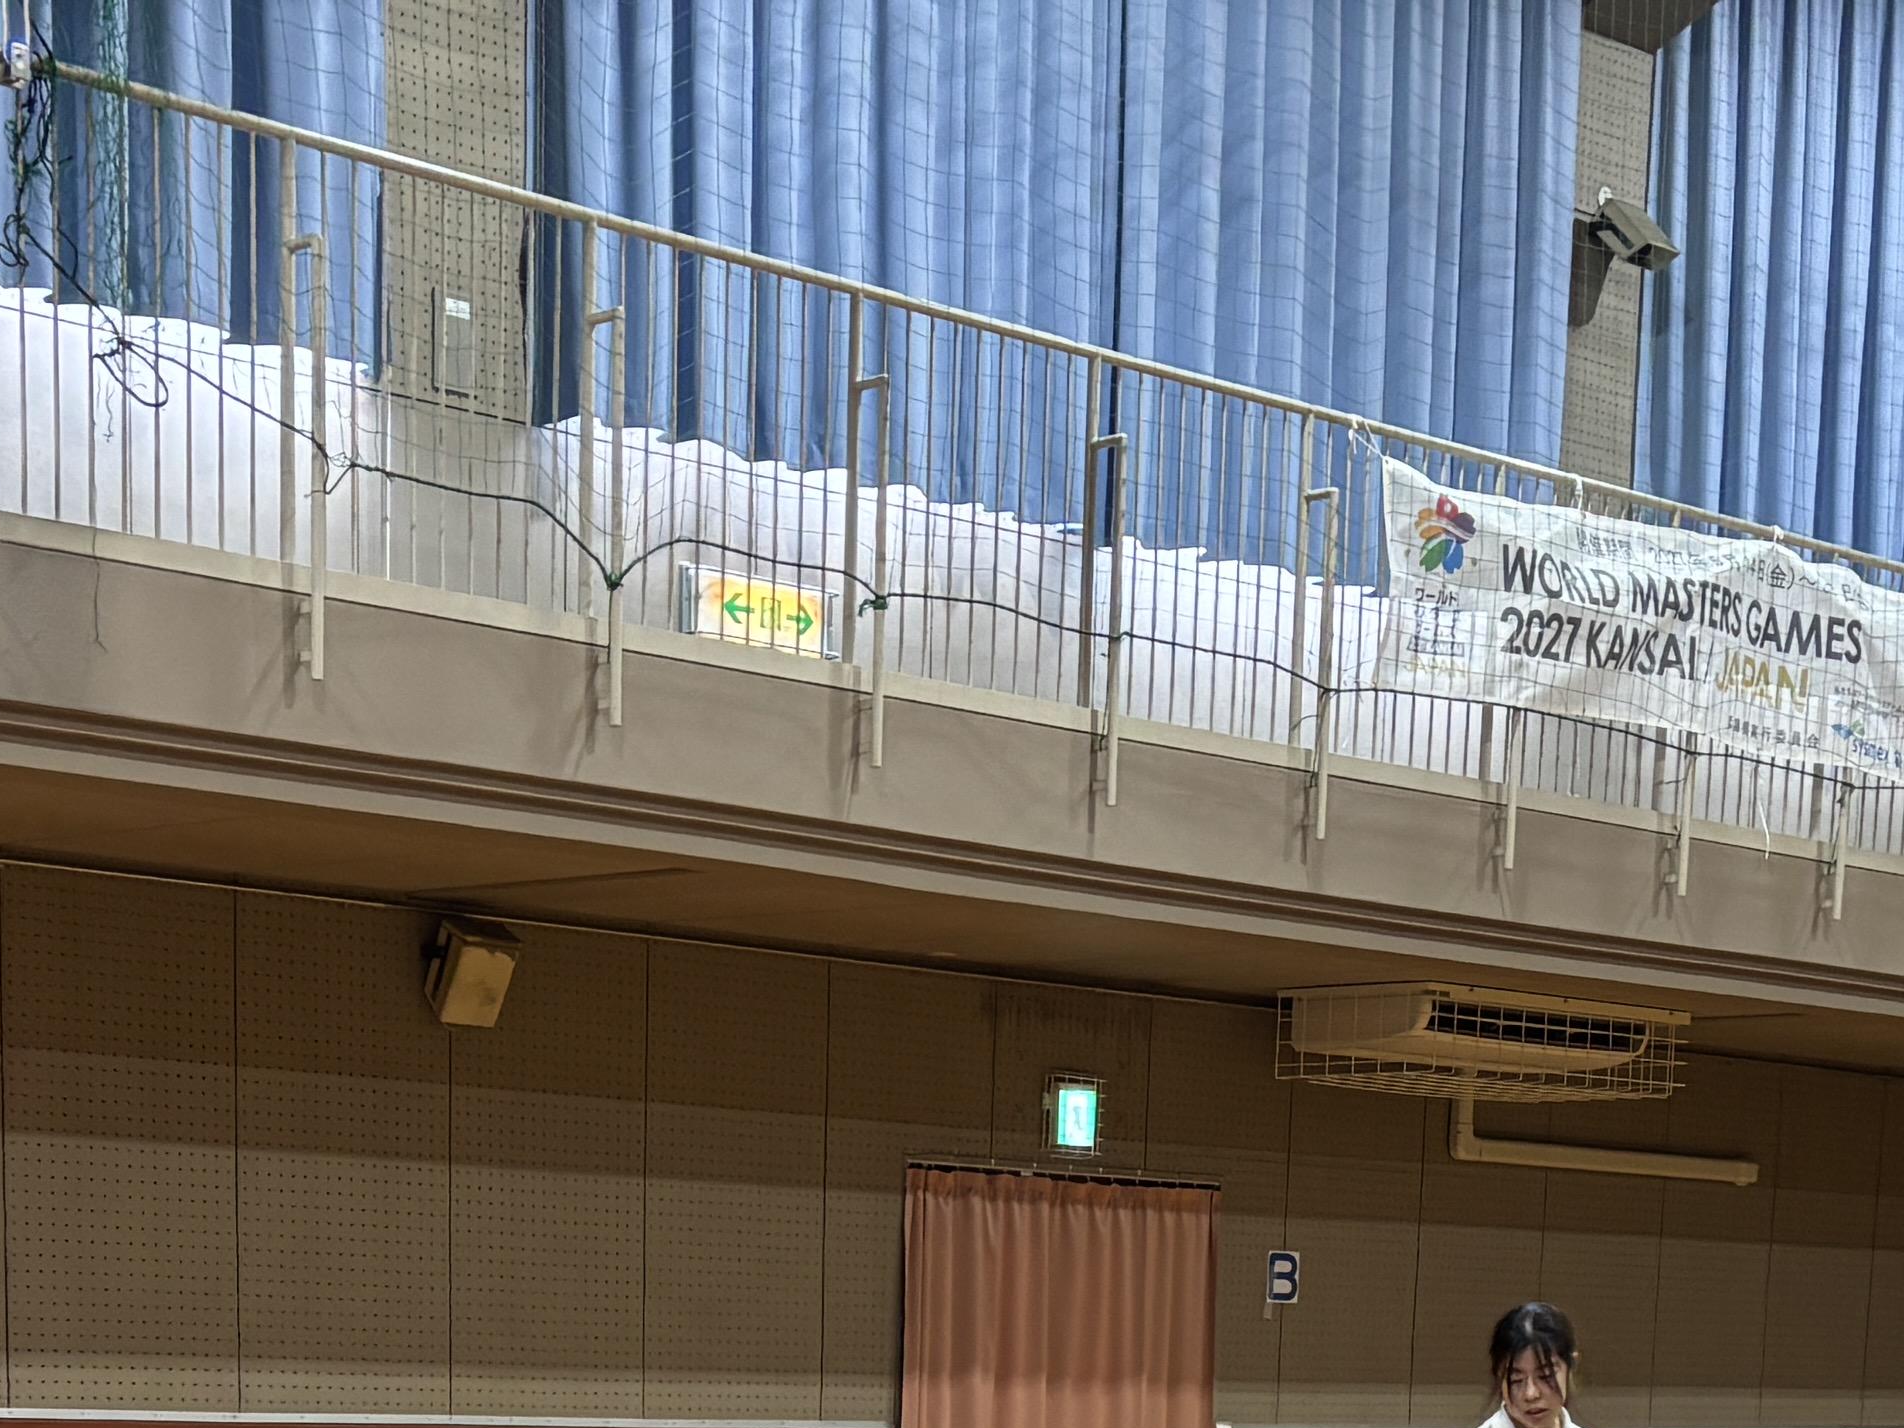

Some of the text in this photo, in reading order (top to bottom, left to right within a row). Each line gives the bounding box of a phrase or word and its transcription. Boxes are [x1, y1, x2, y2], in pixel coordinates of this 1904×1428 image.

[1501, 543, 1863, 664] WORLD MASTERS GAMES
[1499, 606, 1581, 663] 2027
[1585, 618, 1697, 681] KANSAI
[1715, 650, 1810, 714] JAPAN
[1269, 1252, 1297, 1301] B
